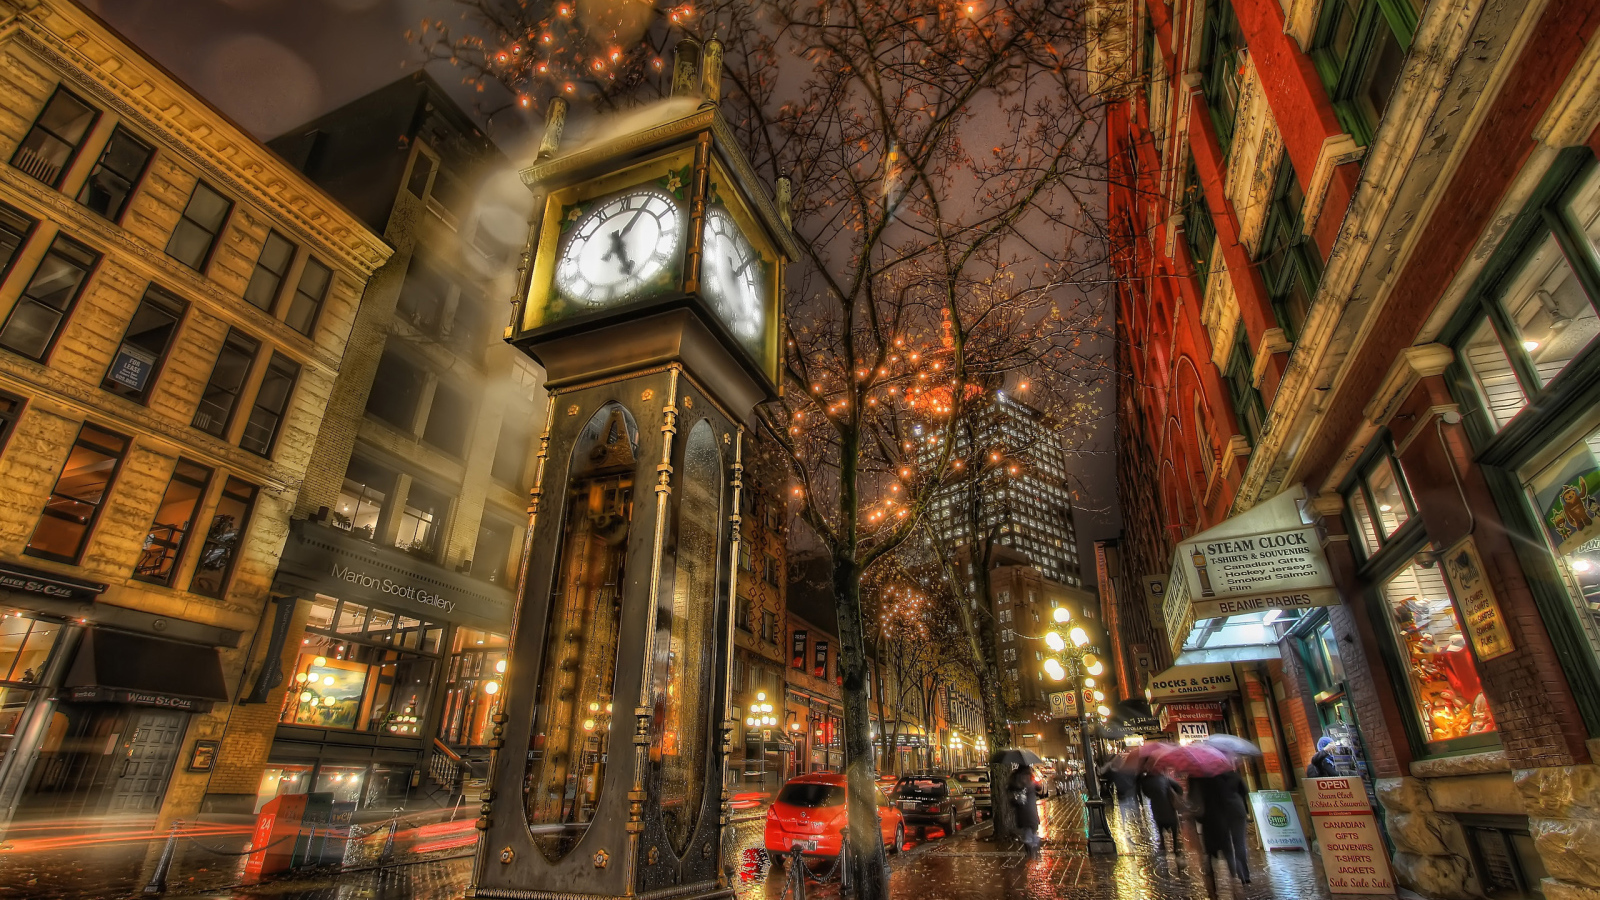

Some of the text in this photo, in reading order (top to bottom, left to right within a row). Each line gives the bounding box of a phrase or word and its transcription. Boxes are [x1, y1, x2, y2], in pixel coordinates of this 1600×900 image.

[124, 362, 142, 374] LEASE
[129, 358, 141, 367] FOR
[1207, 532, 1307, 555] STEAM CLOCK
[1210, 554, 1249, 565] T-SHIRTS
[1260, 546, 1310, 559] SOUVENIRS
[1223, 556, 1306, 571] Canadian Gifts
[1225, 563, 1313, 578] Hockey Jerseys
[1227, 570, 1318, 585] Smoked Salmon
[331, 563, 456, 613] Marion Scott Gallery
[1229, 584, 1252, 592] Film
[1219, 593, 1311, 614] BEANIE BABIES
[1152, 675, 1231, 689] ROCKS & GEMS
[1178, 711, 1214, 719] Jewellery
[1180, 724, 1207, 734] ATM
[1319, 780, 1348, 789] OPEN
[1318, 791, 1354, 800] Steam Clock
[261, 818, 271, 830] 24
[1323, 821, 1366, 829] CANADIAN
[1335, 832, 1359, 840] GIFTS
[1327, 843, 1374, 851] SOUVENIRS
[1335, 855, 1372, 863] T-SHIRTS
[1330, 877, 1391, 889] Sale Sale Sale
